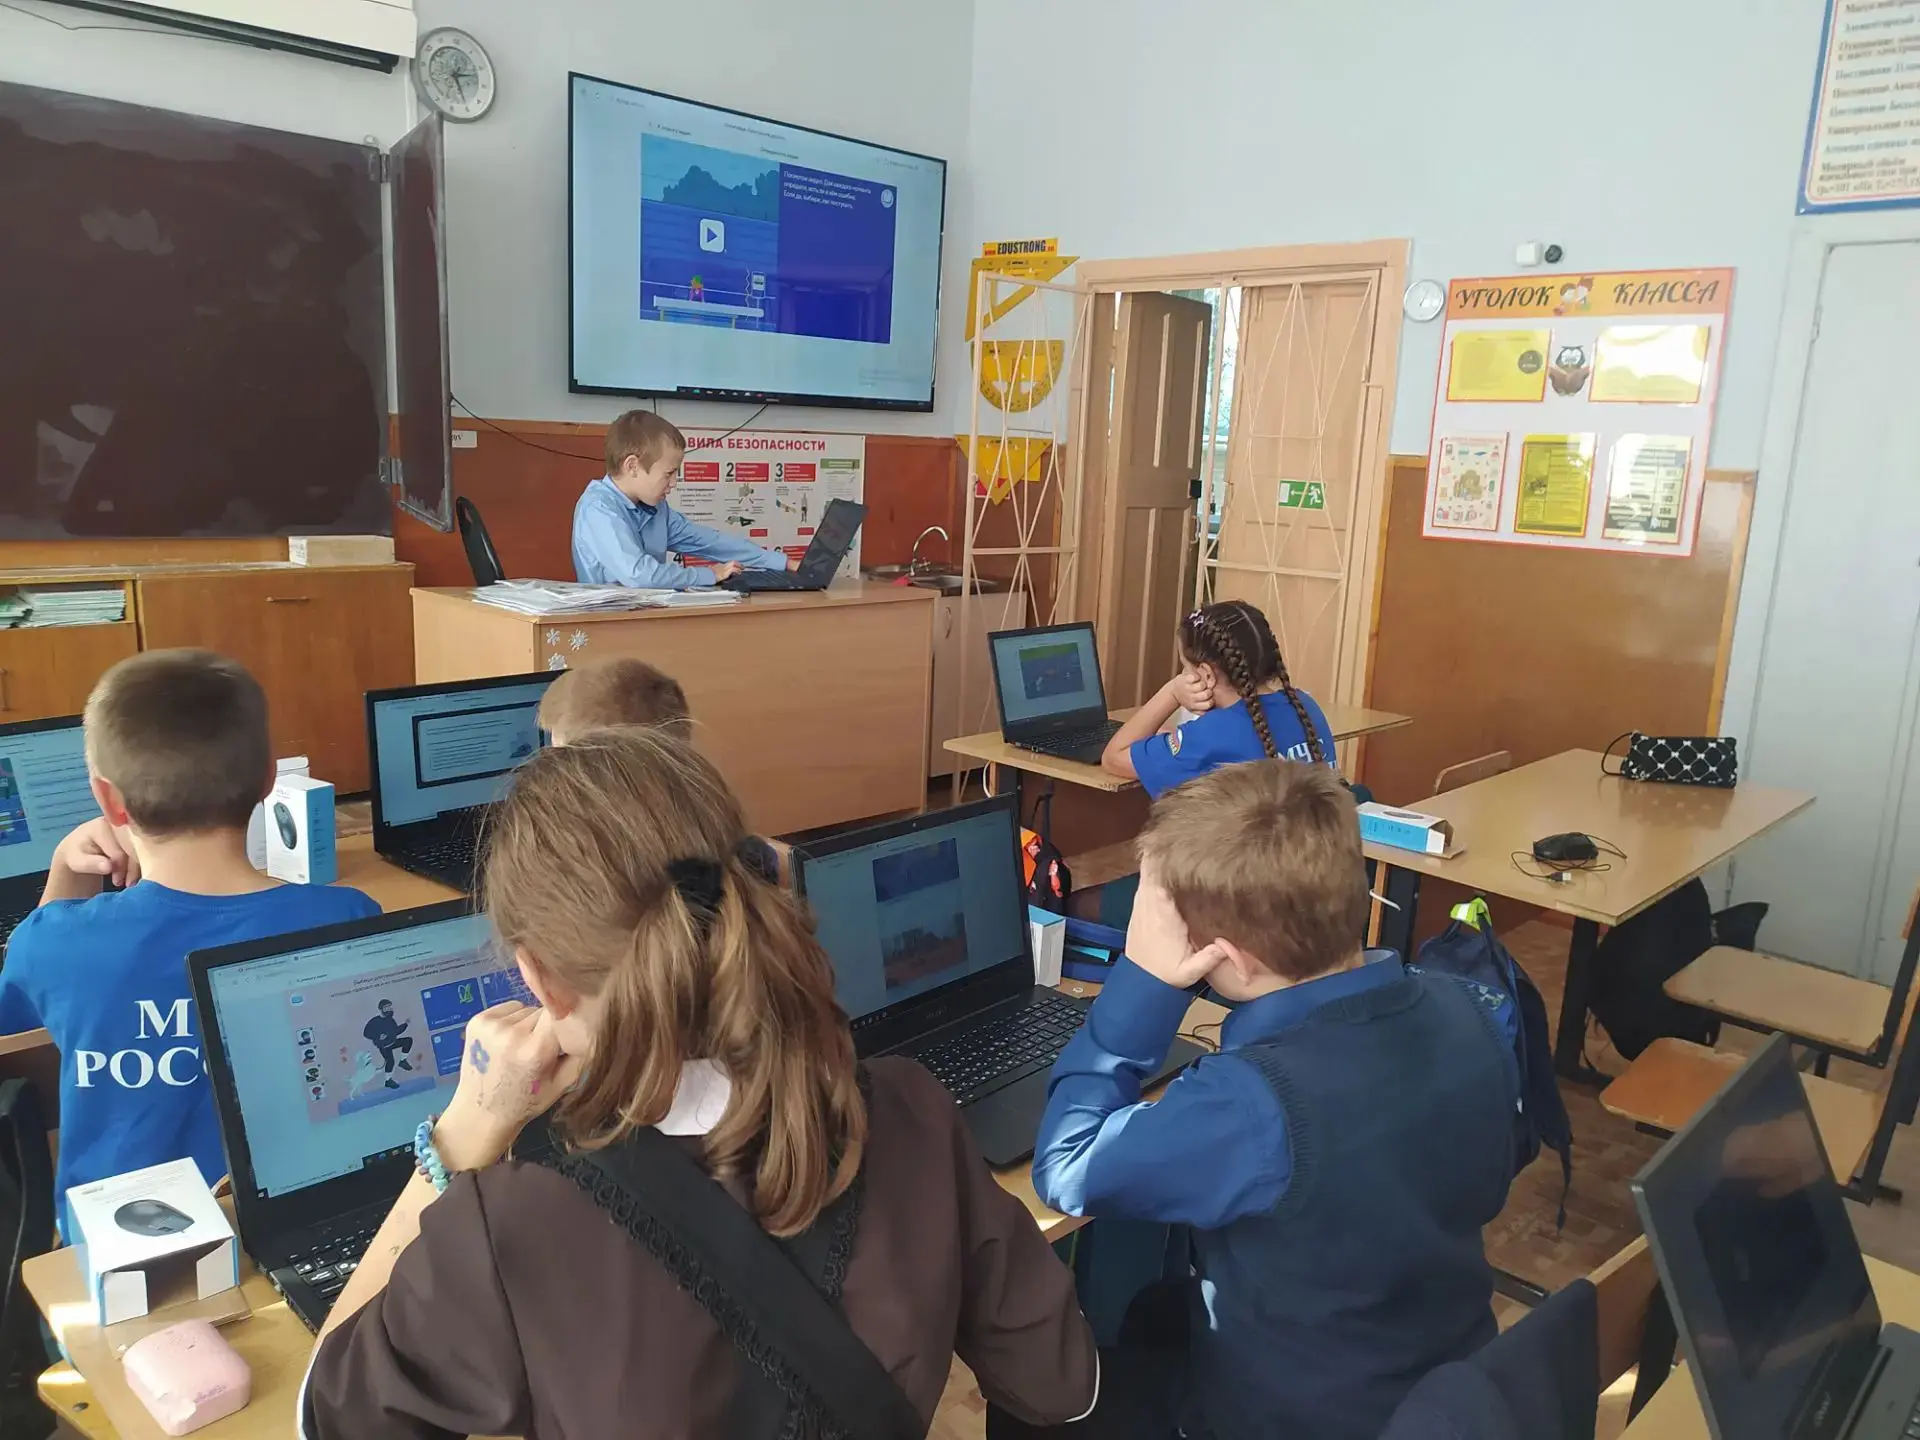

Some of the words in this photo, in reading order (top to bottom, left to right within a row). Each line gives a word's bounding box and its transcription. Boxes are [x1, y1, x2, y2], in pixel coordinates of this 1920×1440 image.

[1455, 285, 1554, 309] УГОЛОК
[1613, 280, 1720, 306] КЛАССА
[684, 437, 724, 449] ВИЛА
[728, 439, 826, 451] БЕЗОПАСНОСТИ
[726, 462, 734, 477] 2
[776, 462, 783, 477] 3
[74, 1046, 208, 1089] РОС
